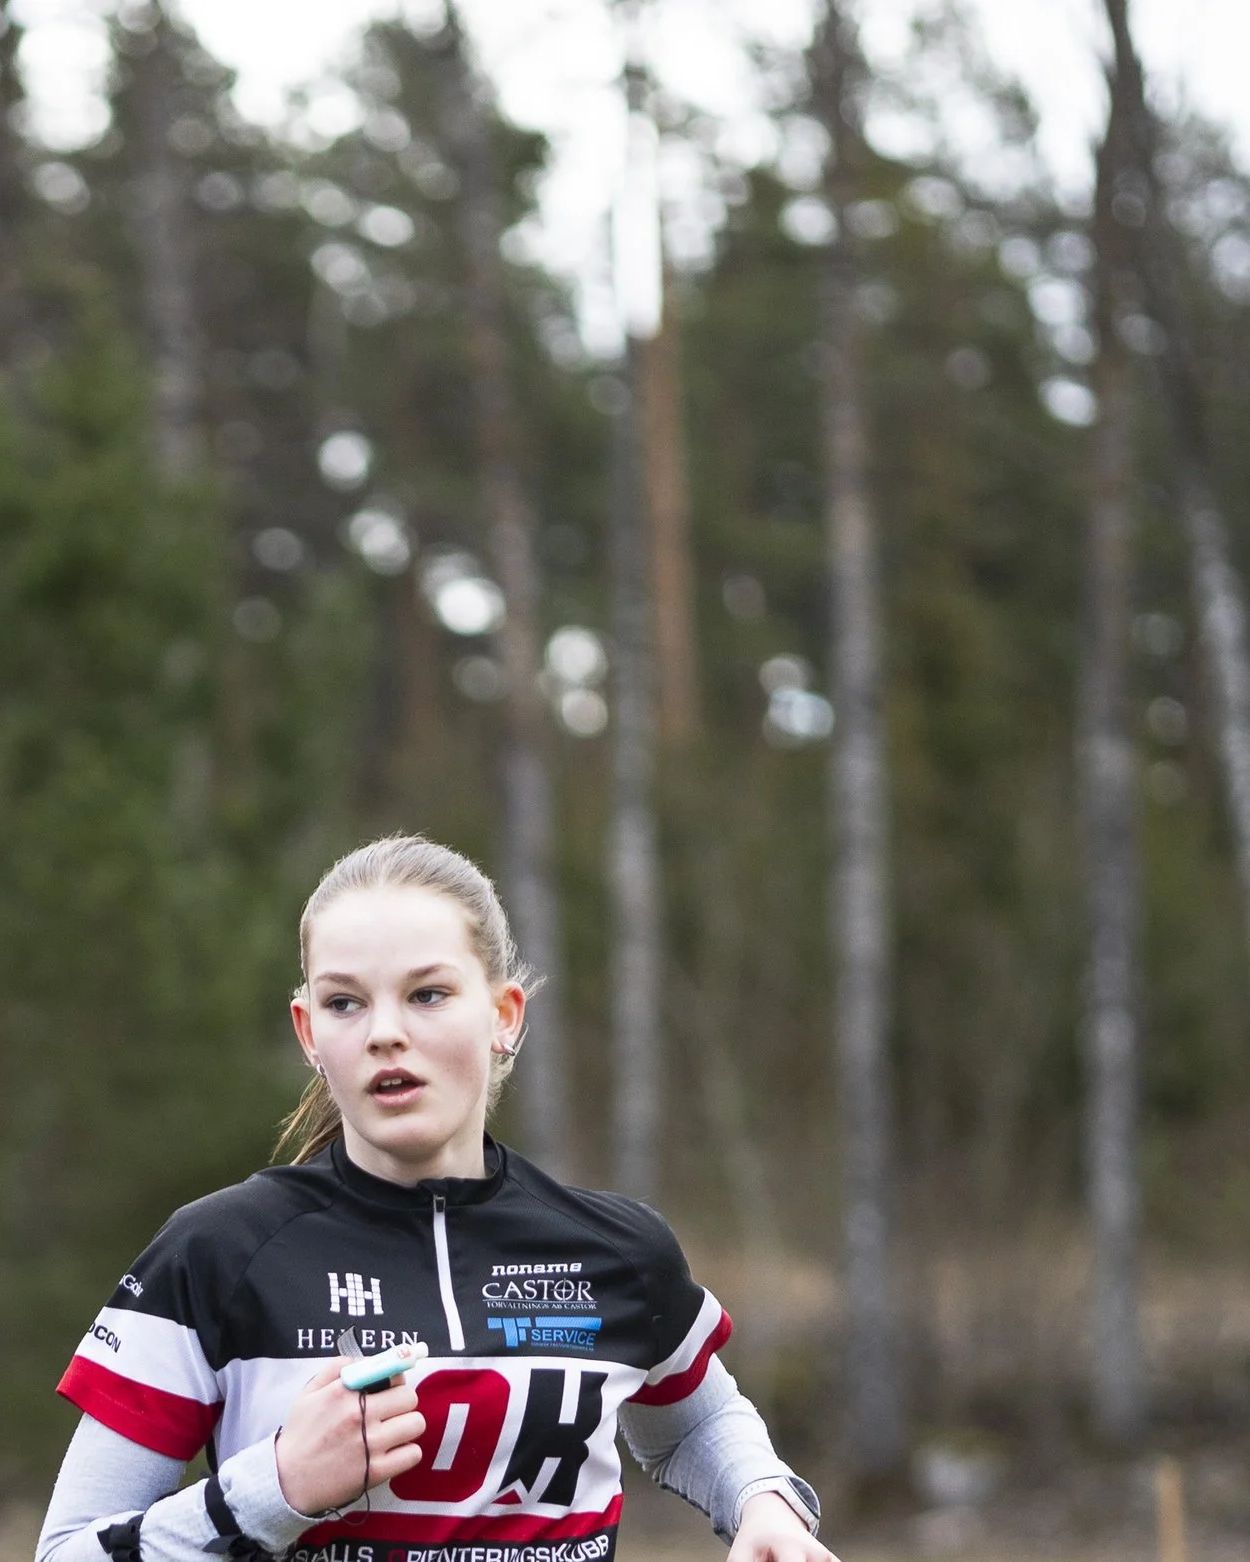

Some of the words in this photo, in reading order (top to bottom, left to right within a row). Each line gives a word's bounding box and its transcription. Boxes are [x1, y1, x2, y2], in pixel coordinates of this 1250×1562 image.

[492, 1263, 582, 1276] noname
[482, 1279, 594, 1301] CASTOR
[297, 1328, 419, 1349] HEERN
[531, 1328, 596, 1346] SERVICE
